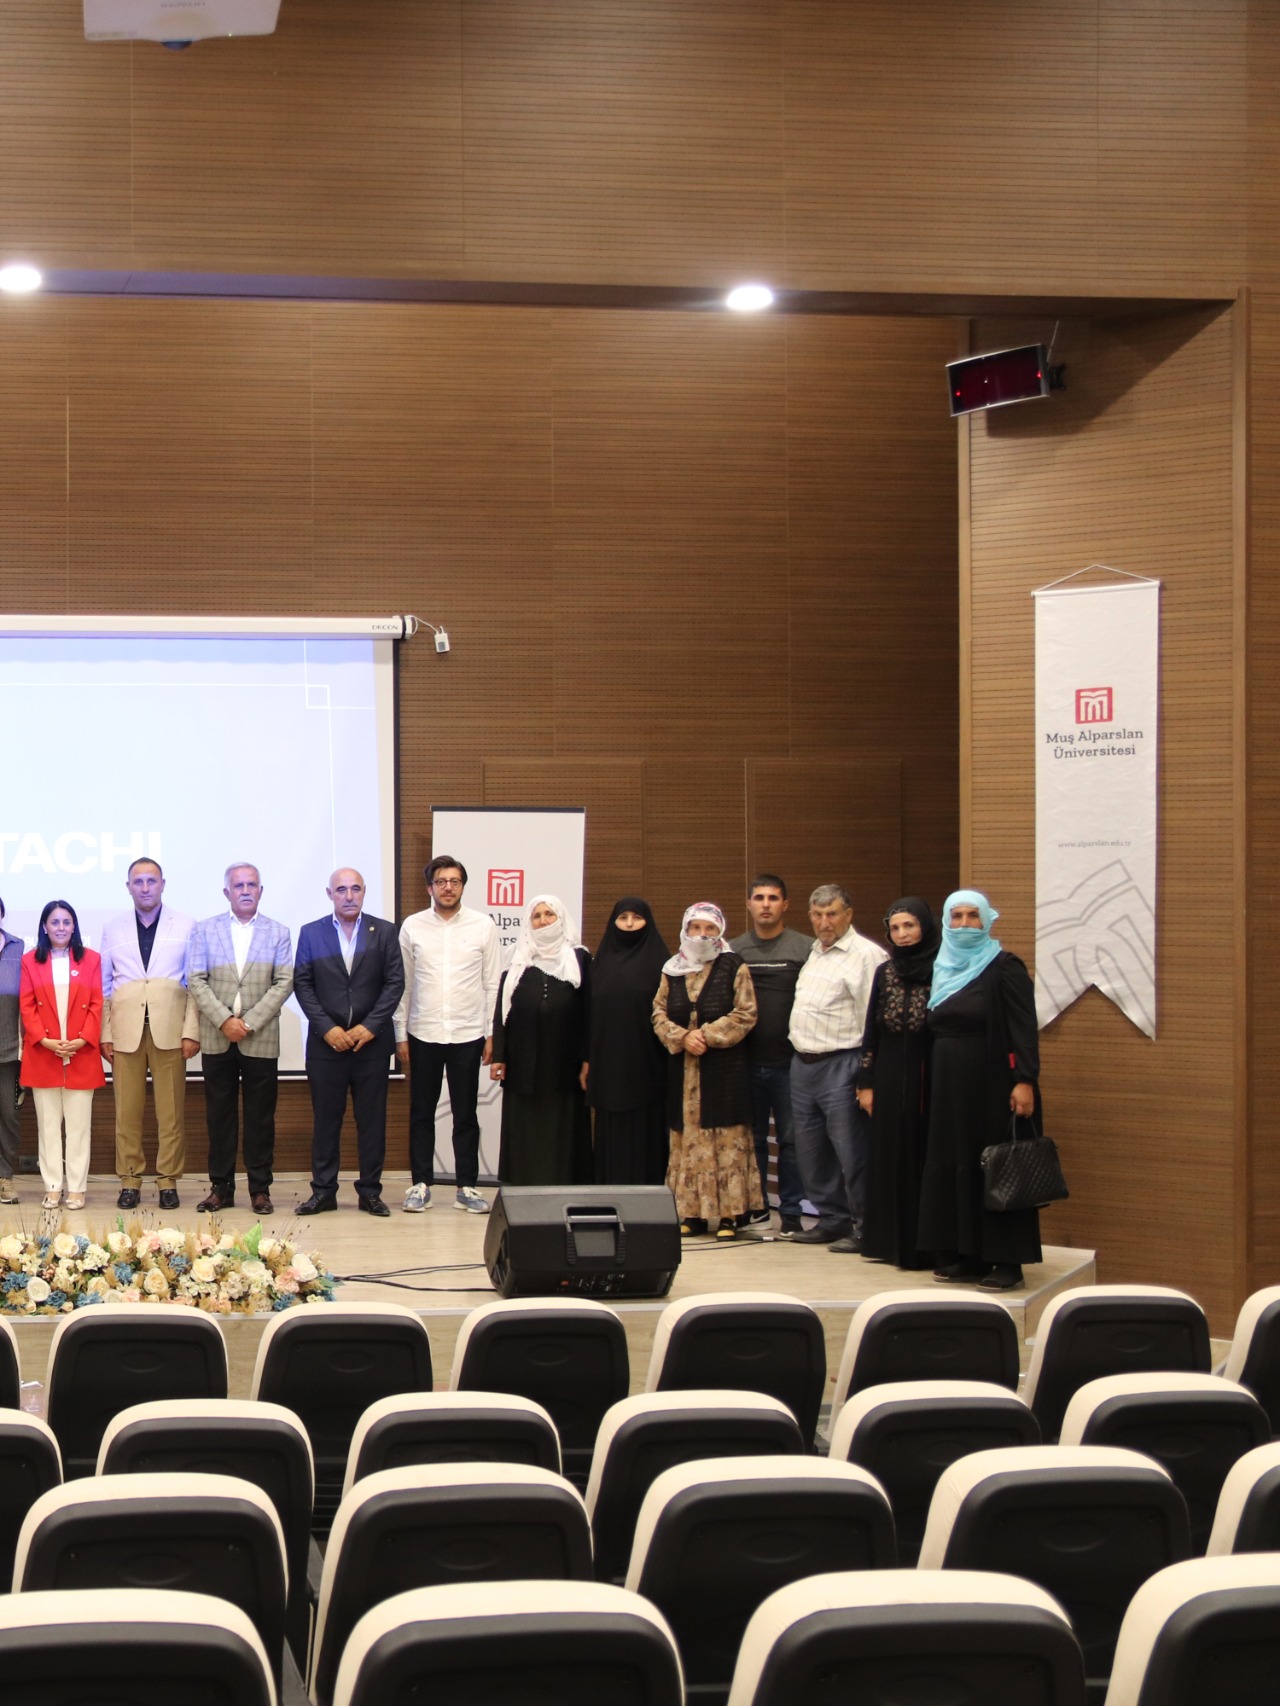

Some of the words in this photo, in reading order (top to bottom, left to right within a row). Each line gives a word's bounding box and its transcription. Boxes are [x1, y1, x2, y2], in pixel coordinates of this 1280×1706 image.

[1046, 733, 1074, 745] Muş
[1078, 729, 1144, 743] Alparslan
[1054, 744, 1136, 759] Üniversitesi
